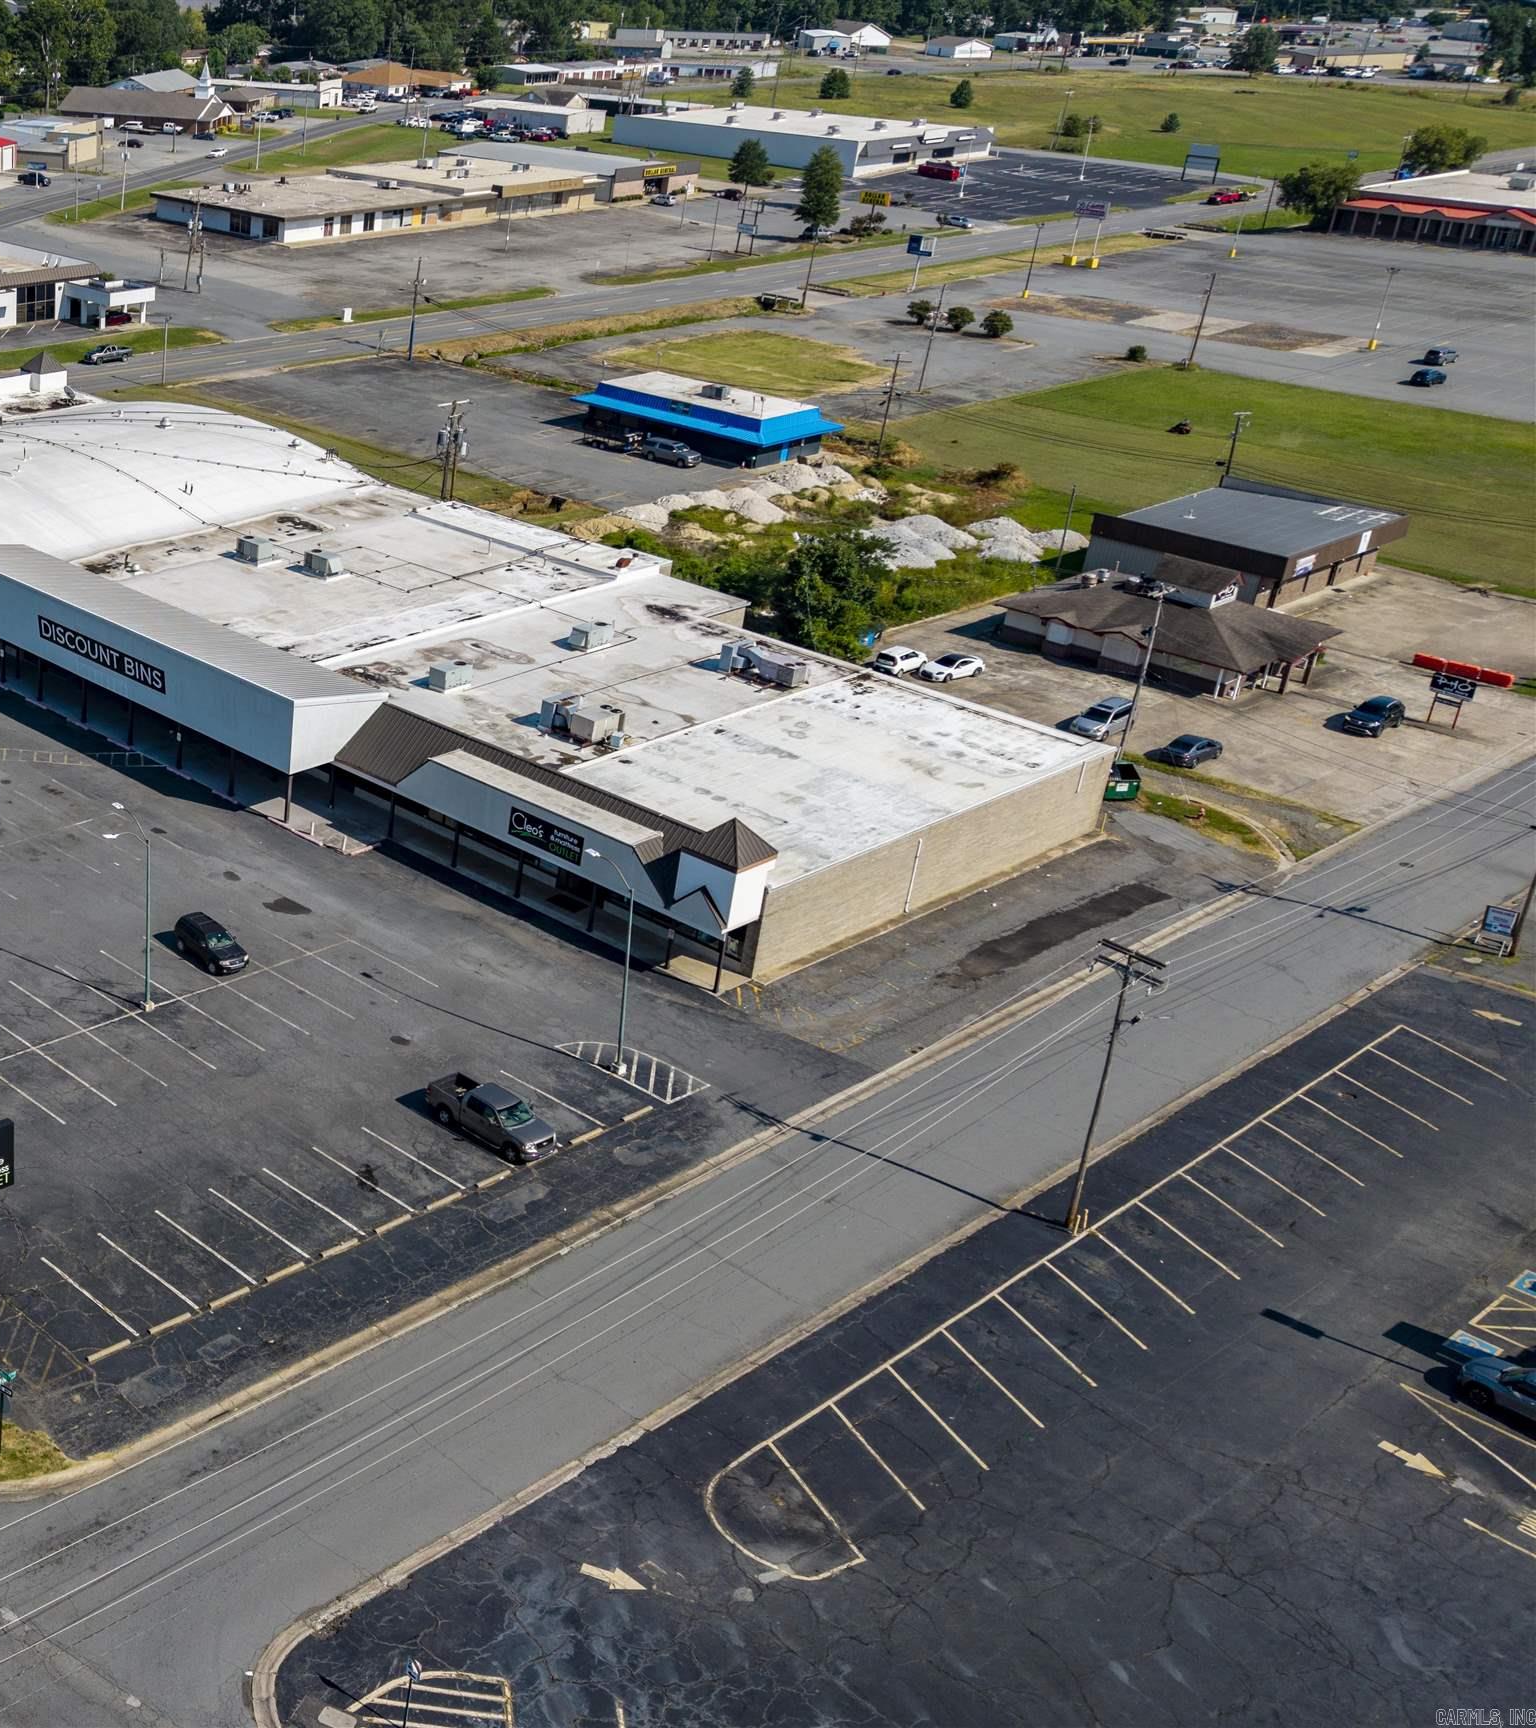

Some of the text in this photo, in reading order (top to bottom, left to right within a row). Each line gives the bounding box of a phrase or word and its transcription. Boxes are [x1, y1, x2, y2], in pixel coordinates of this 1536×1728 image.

[41, 619, 162, 689] DISCOUNT BINS
[512, 812, 544, 838] Cleo's
[553, 829, 578, 845] furniture
[548, 842, 578, 861] OUTLET
